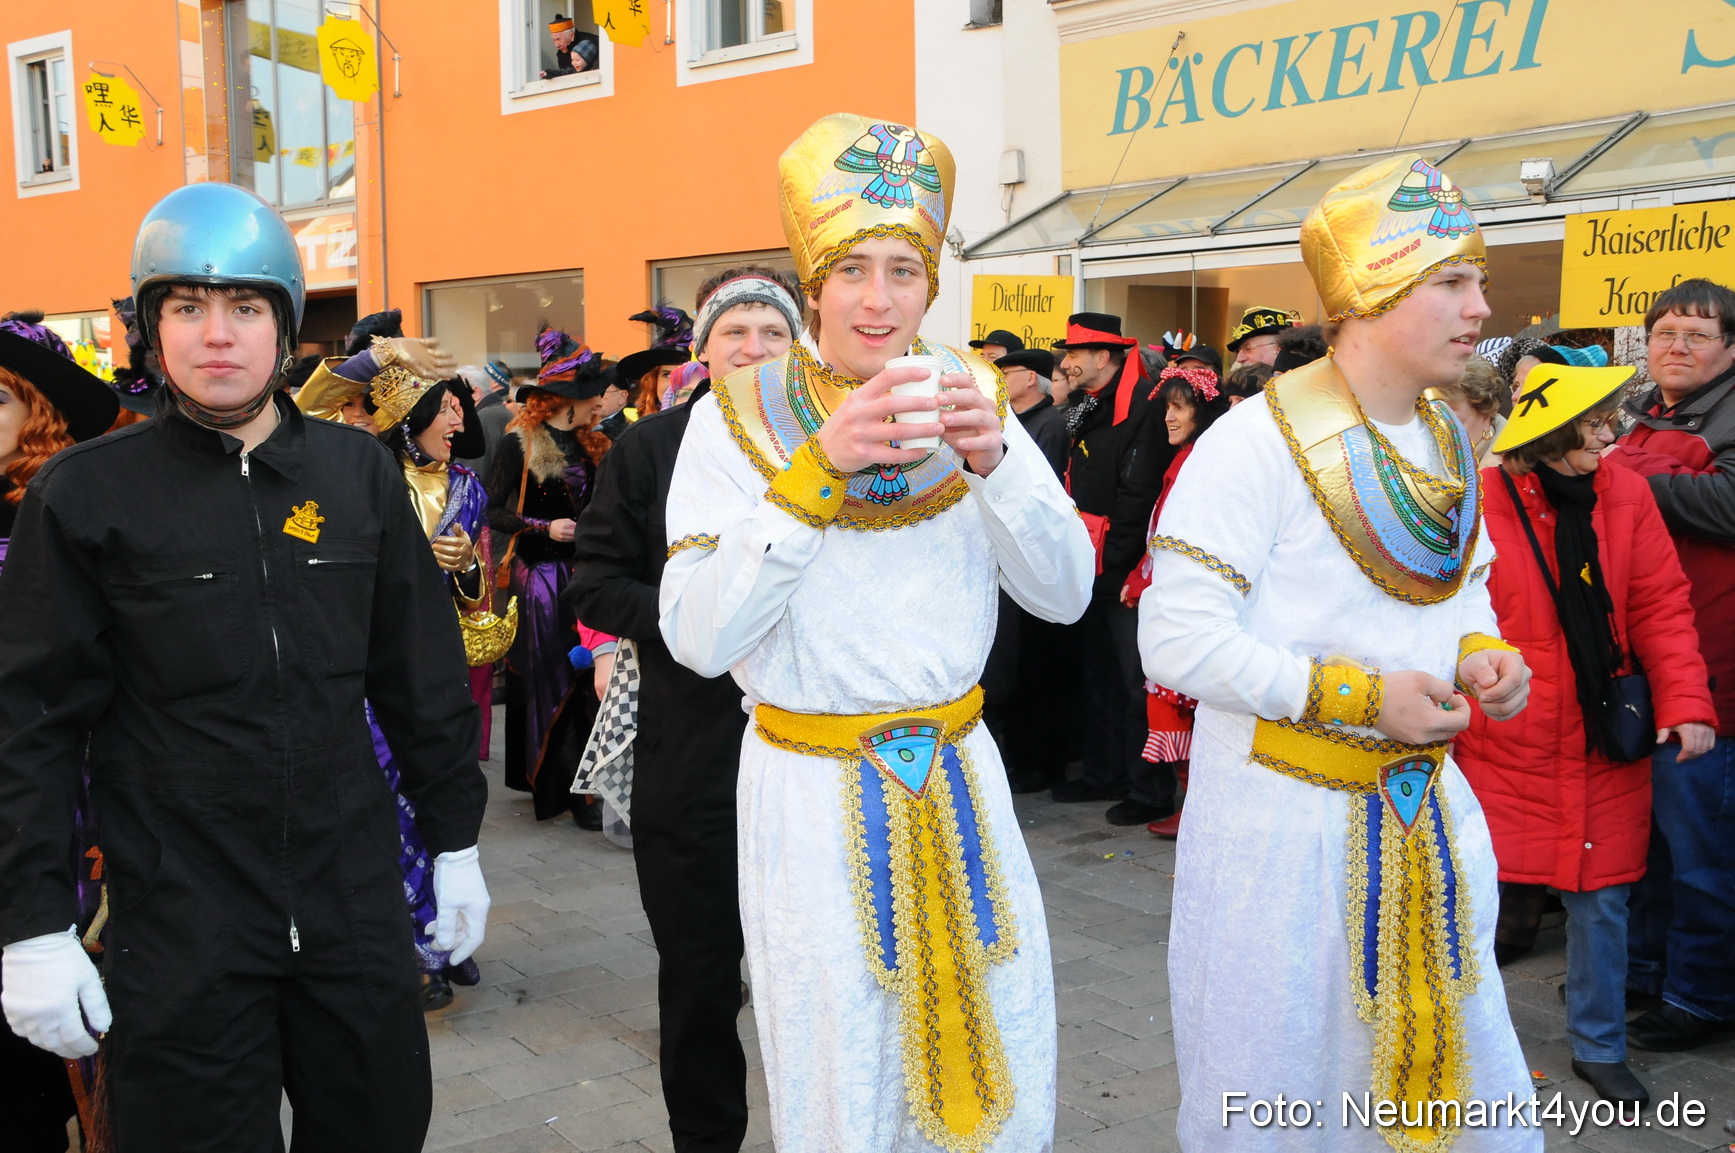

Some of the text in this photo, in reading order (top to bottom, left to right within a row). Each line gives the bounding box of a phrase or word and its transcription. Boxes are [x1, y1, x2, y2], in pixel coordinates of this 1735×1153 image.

[1106, 0, 1549, 136] BÄCKEREI
[1583, 211, 1731, 257] Kaiserliche
[990, 282, 1055, 317] Dietfurter
